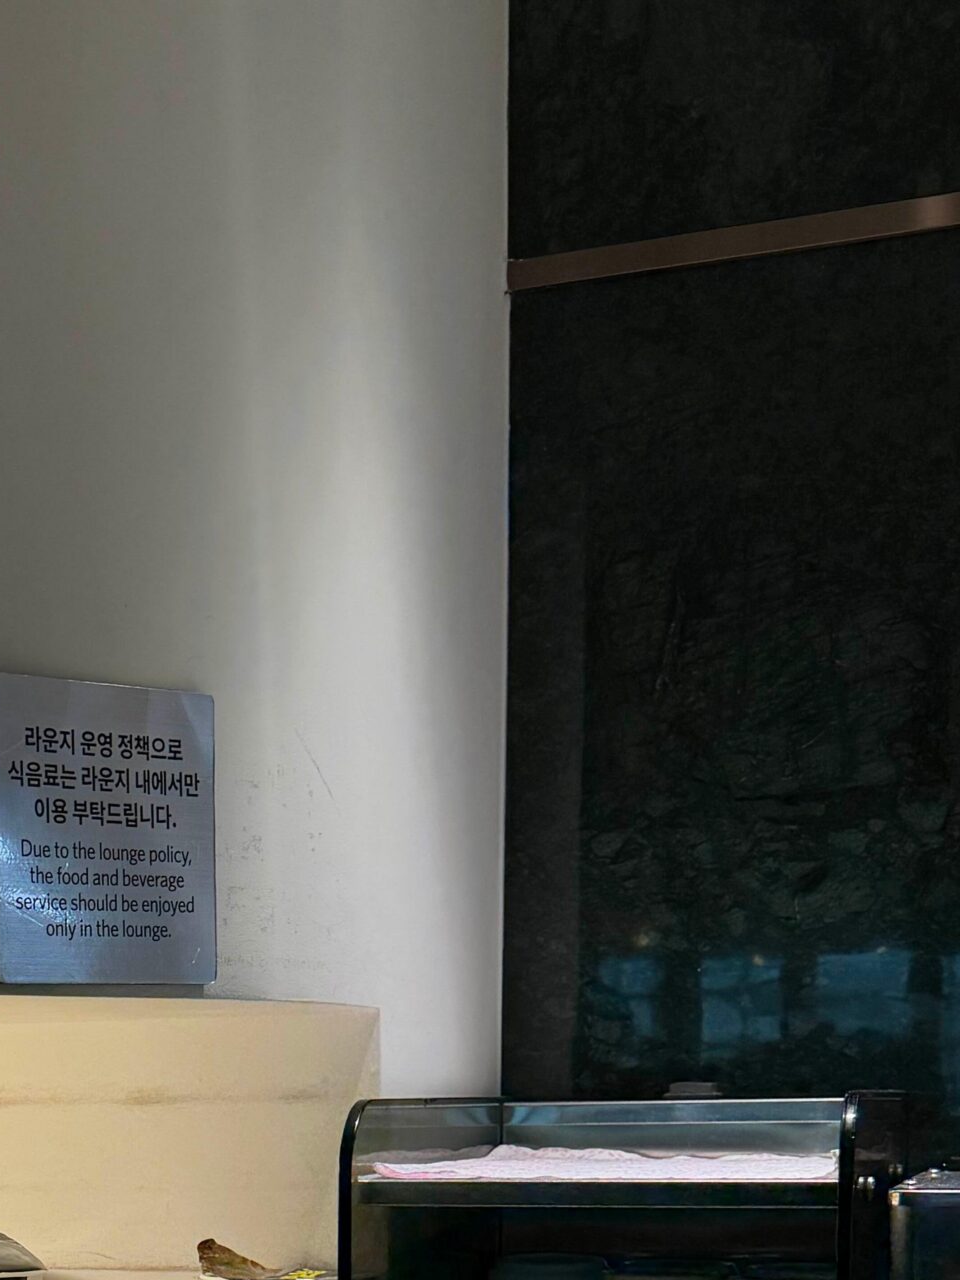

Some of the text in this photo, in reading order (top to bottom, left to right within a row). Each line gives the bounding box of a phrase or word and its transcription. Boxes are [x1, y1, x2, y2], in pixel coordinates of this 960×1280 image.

[25, 725, 184, 762] 라운지 운영 정책으로
[8, 759, 201, 798] 식음료는 라운지 내에서만
[34, 796, 177, 830] 이용 부탁드립니다.
[20, 838, 192, 868] Due to the lounge policy,
[30, 866, 185, 891] the food and beverage
[15, 894, 195, 917] service should be enjoyed
[46, 919, 172, 942] only in the lounge.
